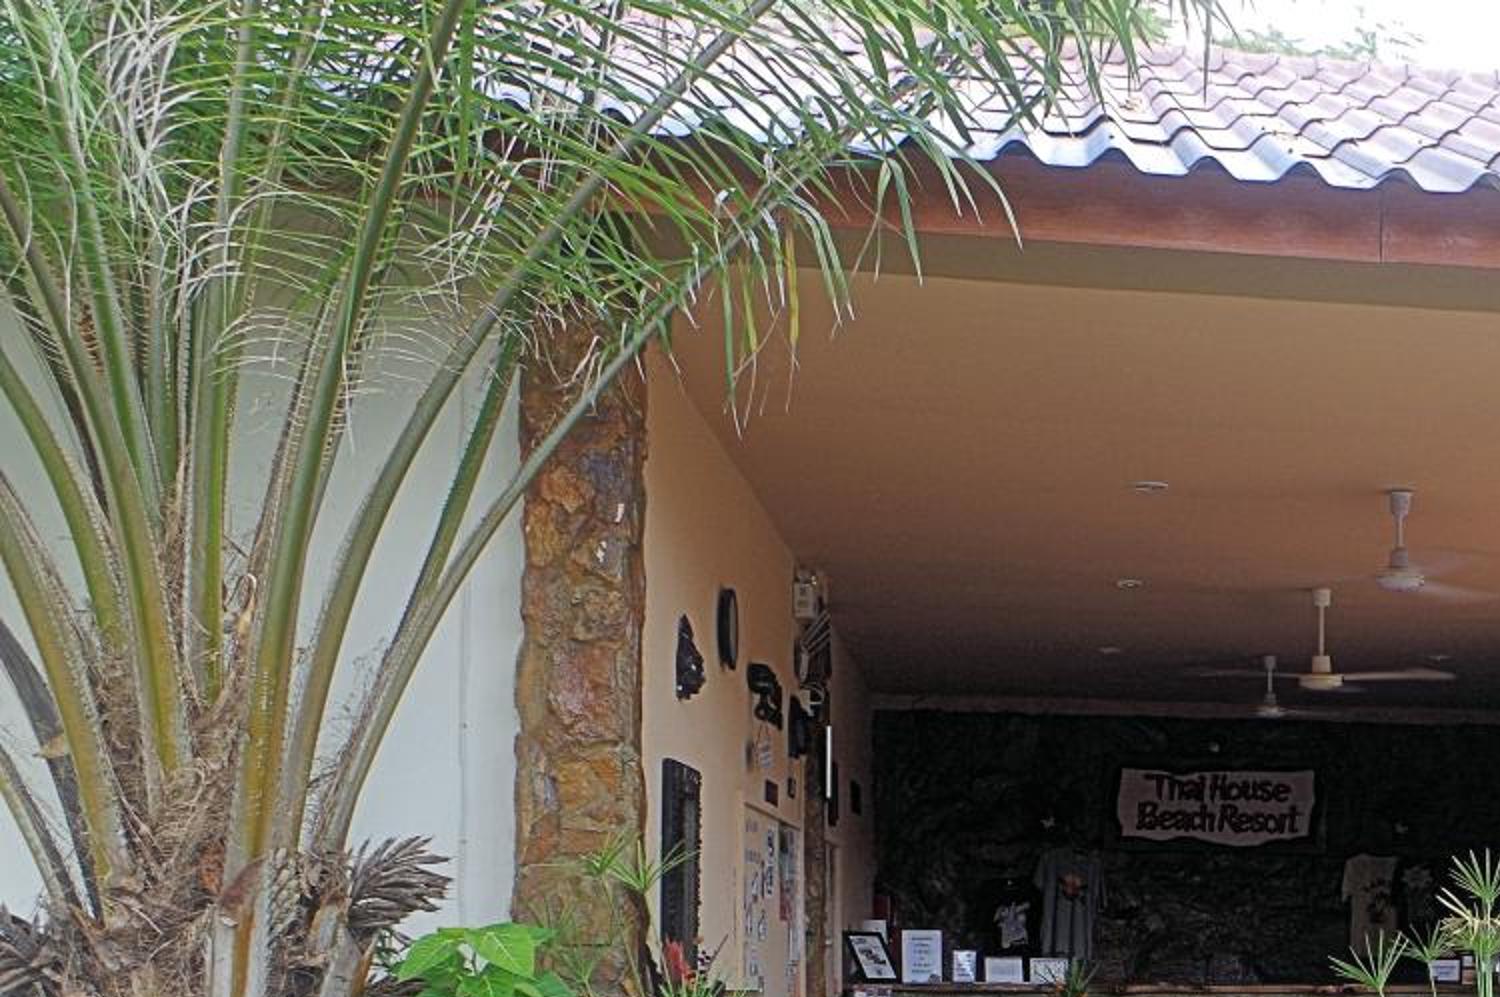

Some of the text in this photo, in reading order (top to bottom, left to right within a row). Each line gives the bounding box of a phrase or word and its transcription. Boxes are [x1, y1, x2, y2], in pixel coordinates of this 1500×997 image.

[1143, 773, 1292, 803] Thai House
[1136, 801, 1303, 834] Beach Resort
